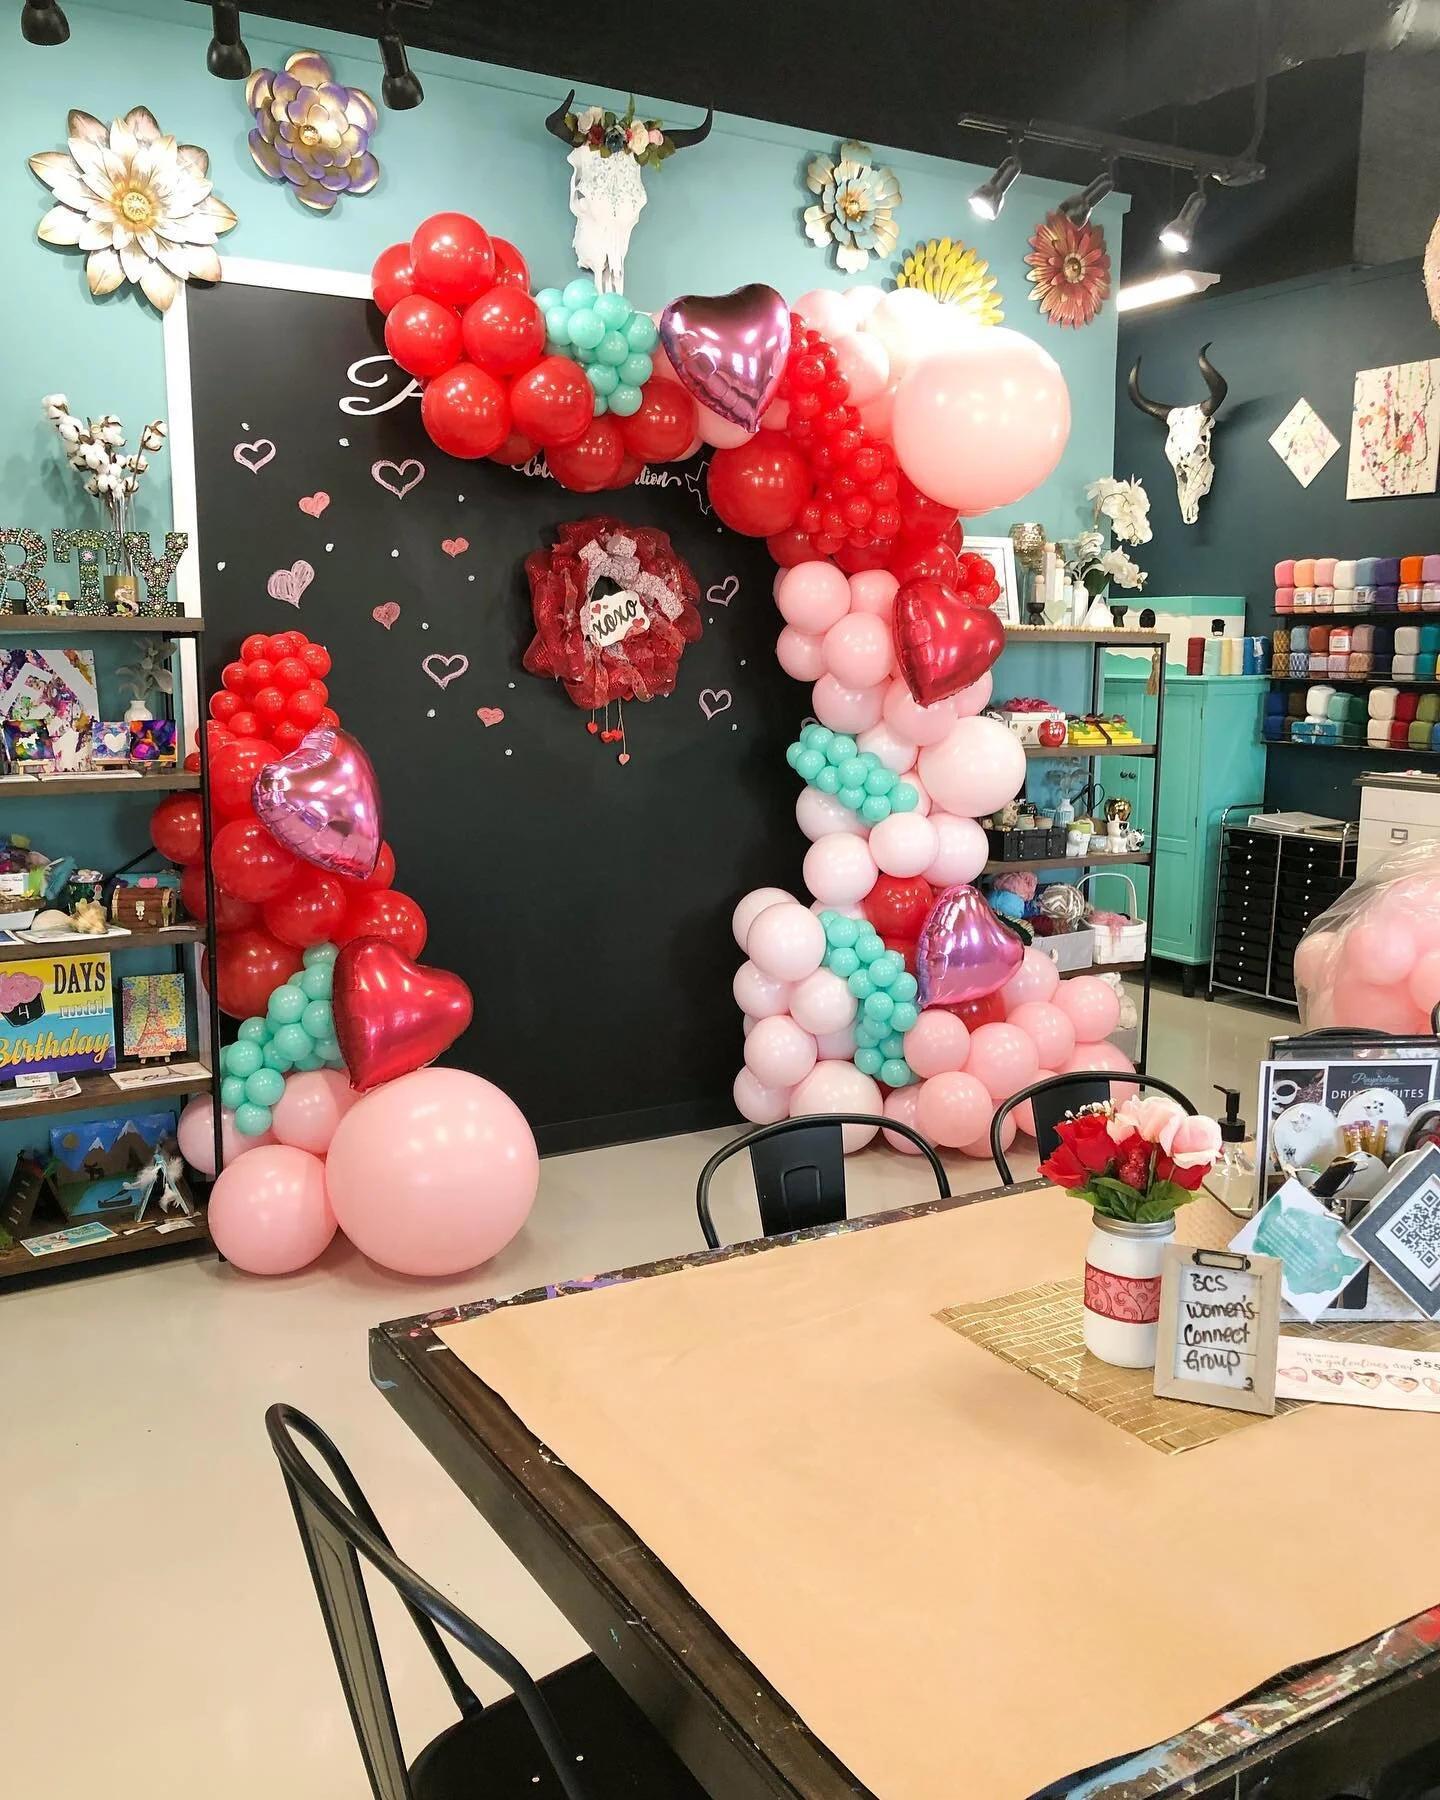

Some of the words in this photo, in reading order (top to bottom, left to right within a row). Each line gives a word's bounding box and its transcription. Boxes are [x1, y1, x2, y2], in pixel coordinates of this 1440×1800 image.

[592, 600, 638, 639] xoxo
[53, 962, 106, 994] DAYS
[18, 1004, 30, 1019] 4
[1184, 1323, 1250, 1346] Connect
[1183, 1349, 1240, 1375] Group
